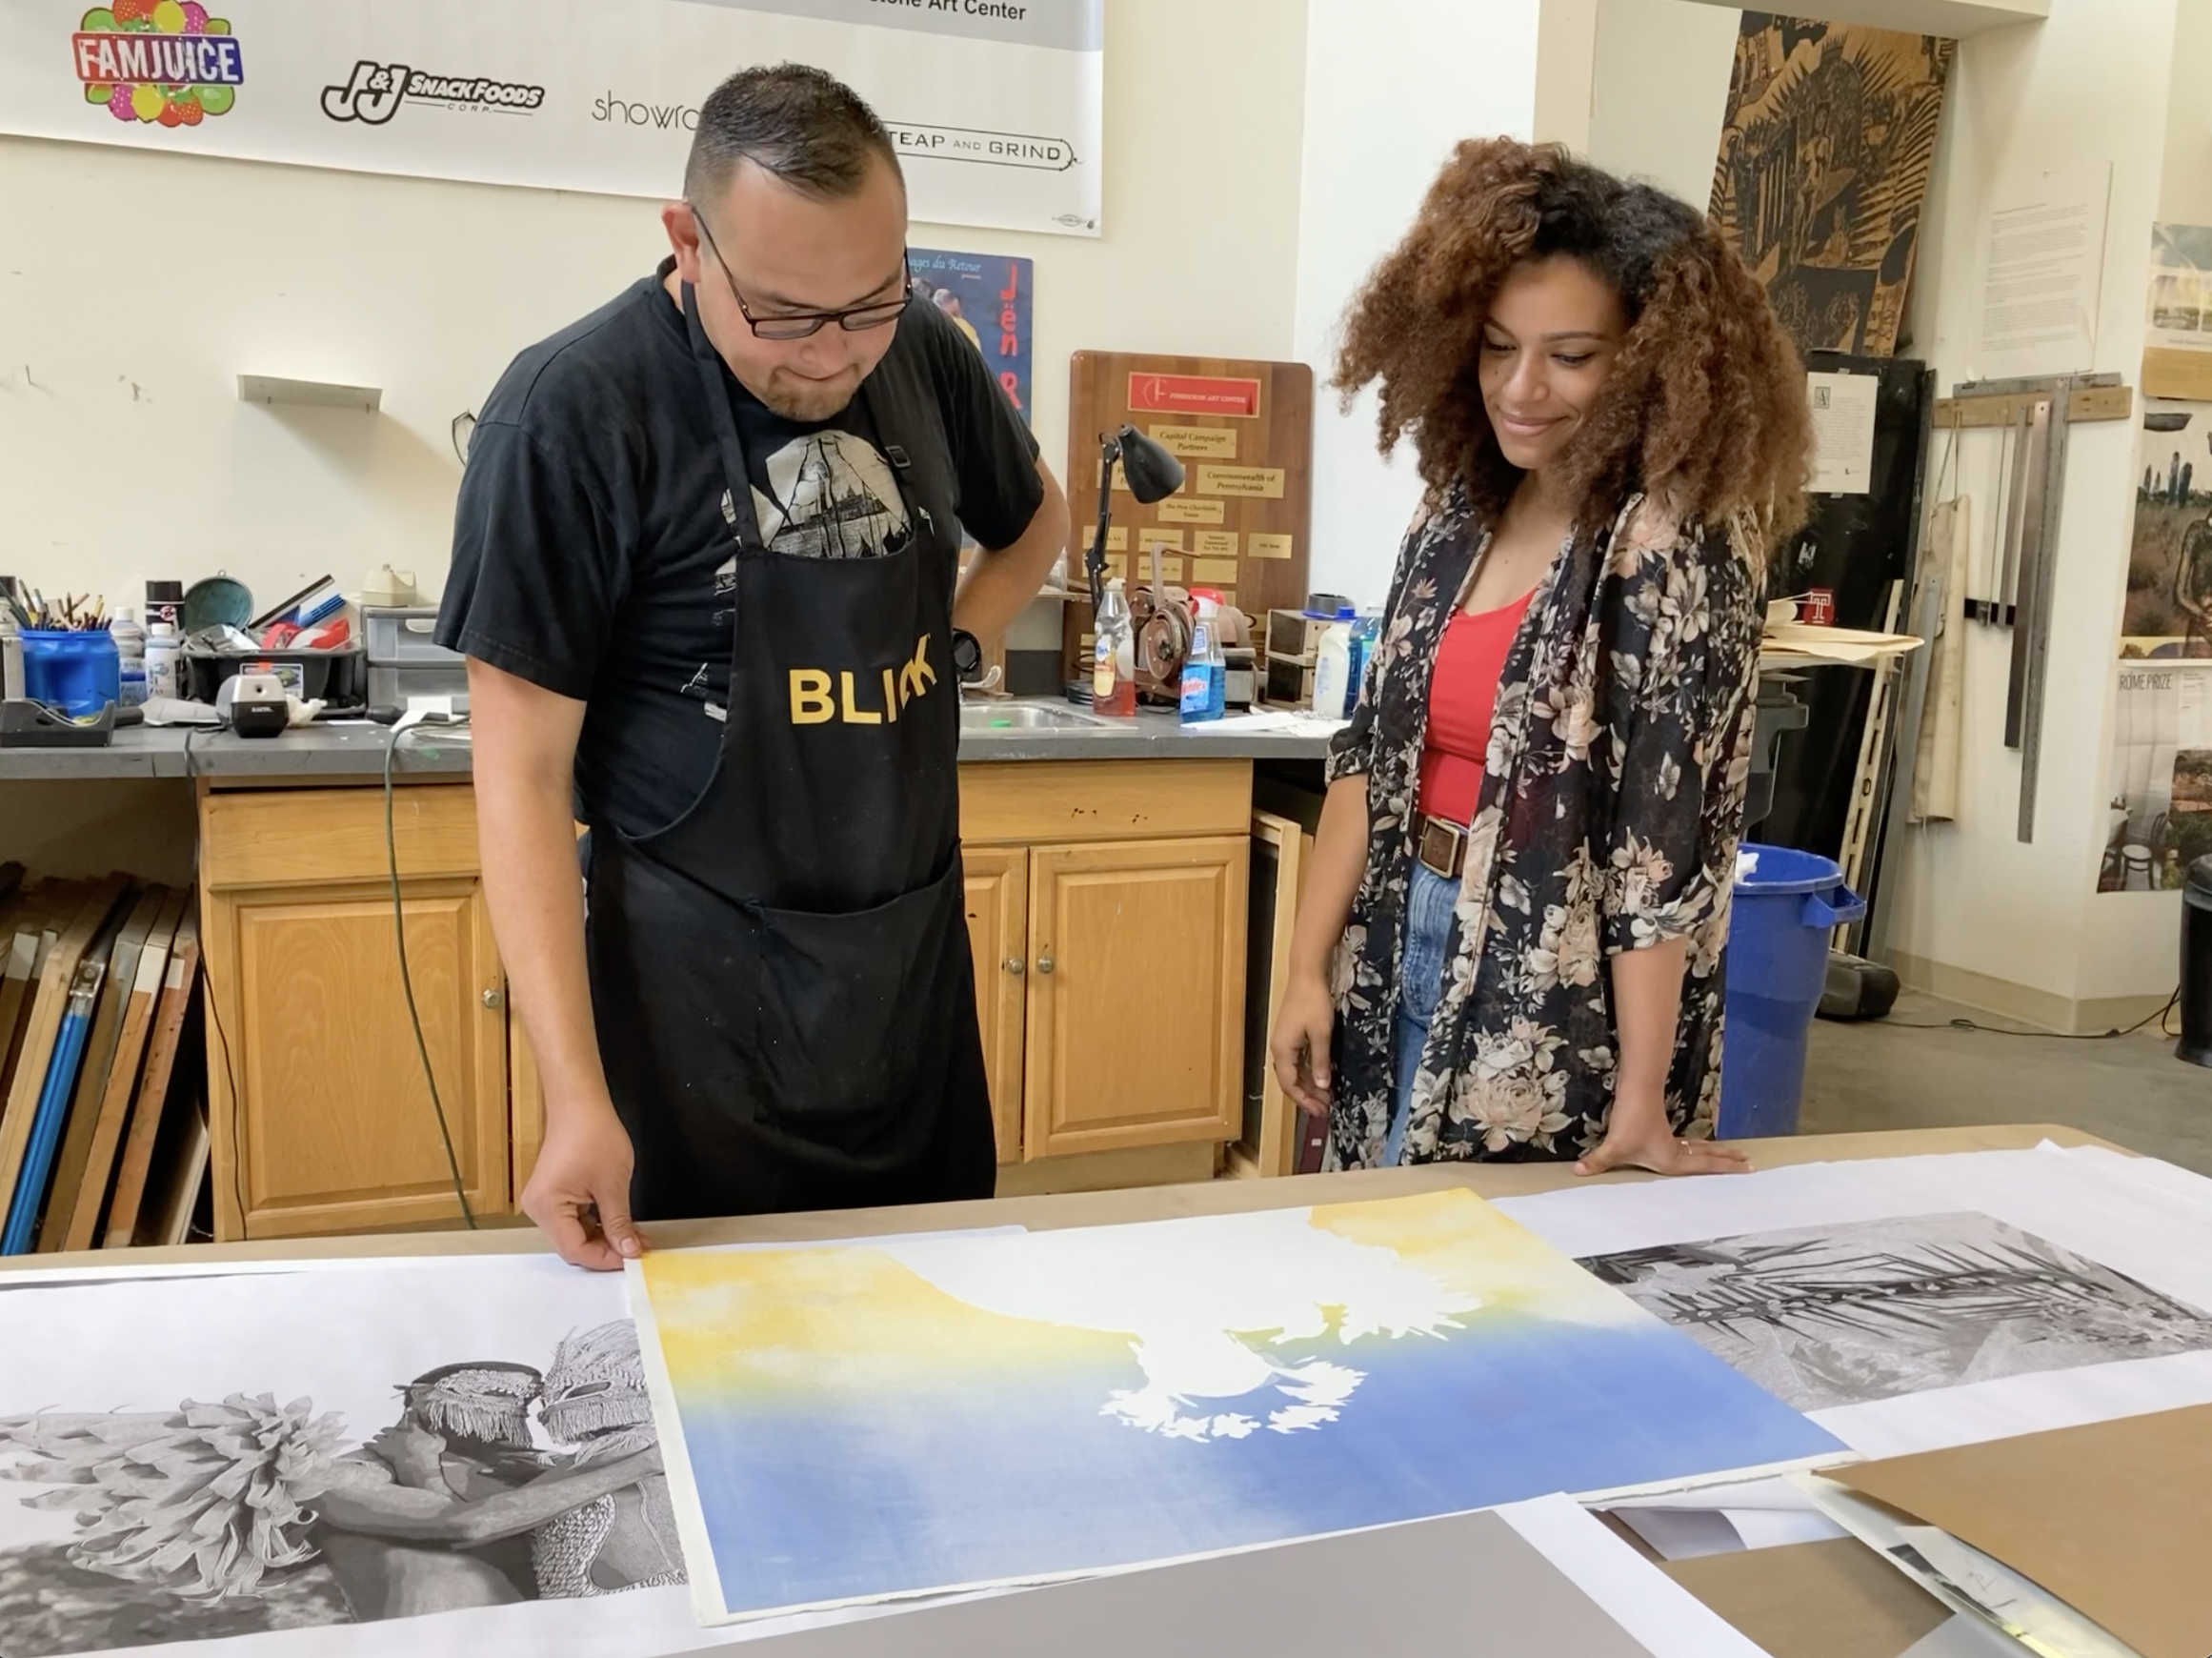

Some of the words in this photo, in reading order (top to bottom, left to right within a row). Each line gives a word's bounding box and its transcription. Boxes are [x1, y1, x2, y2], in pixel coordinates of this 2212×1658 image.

[928, 0, 957, 11] Art
[964, 0, 1026, 20] Center
[77, 38, 240, 82] FAMJUICE
[953, 140, 982, 151] AND
[989, 141, 1061, 160] GRIND
[1159, 431, 1187, 441] Capital
[1189, 432, 1227, 443] Campaign
[1177, 442, 1208, 452] Partners
[1207, 471, 1265, 482] Commonwealth
[1266, 475, 1276, 483] of
[1217, 482, 1264, 493] Pennsylvania
[2120, 674, 2145, 691] ROME
[2147, 673, 2172, 691] PRIZE
